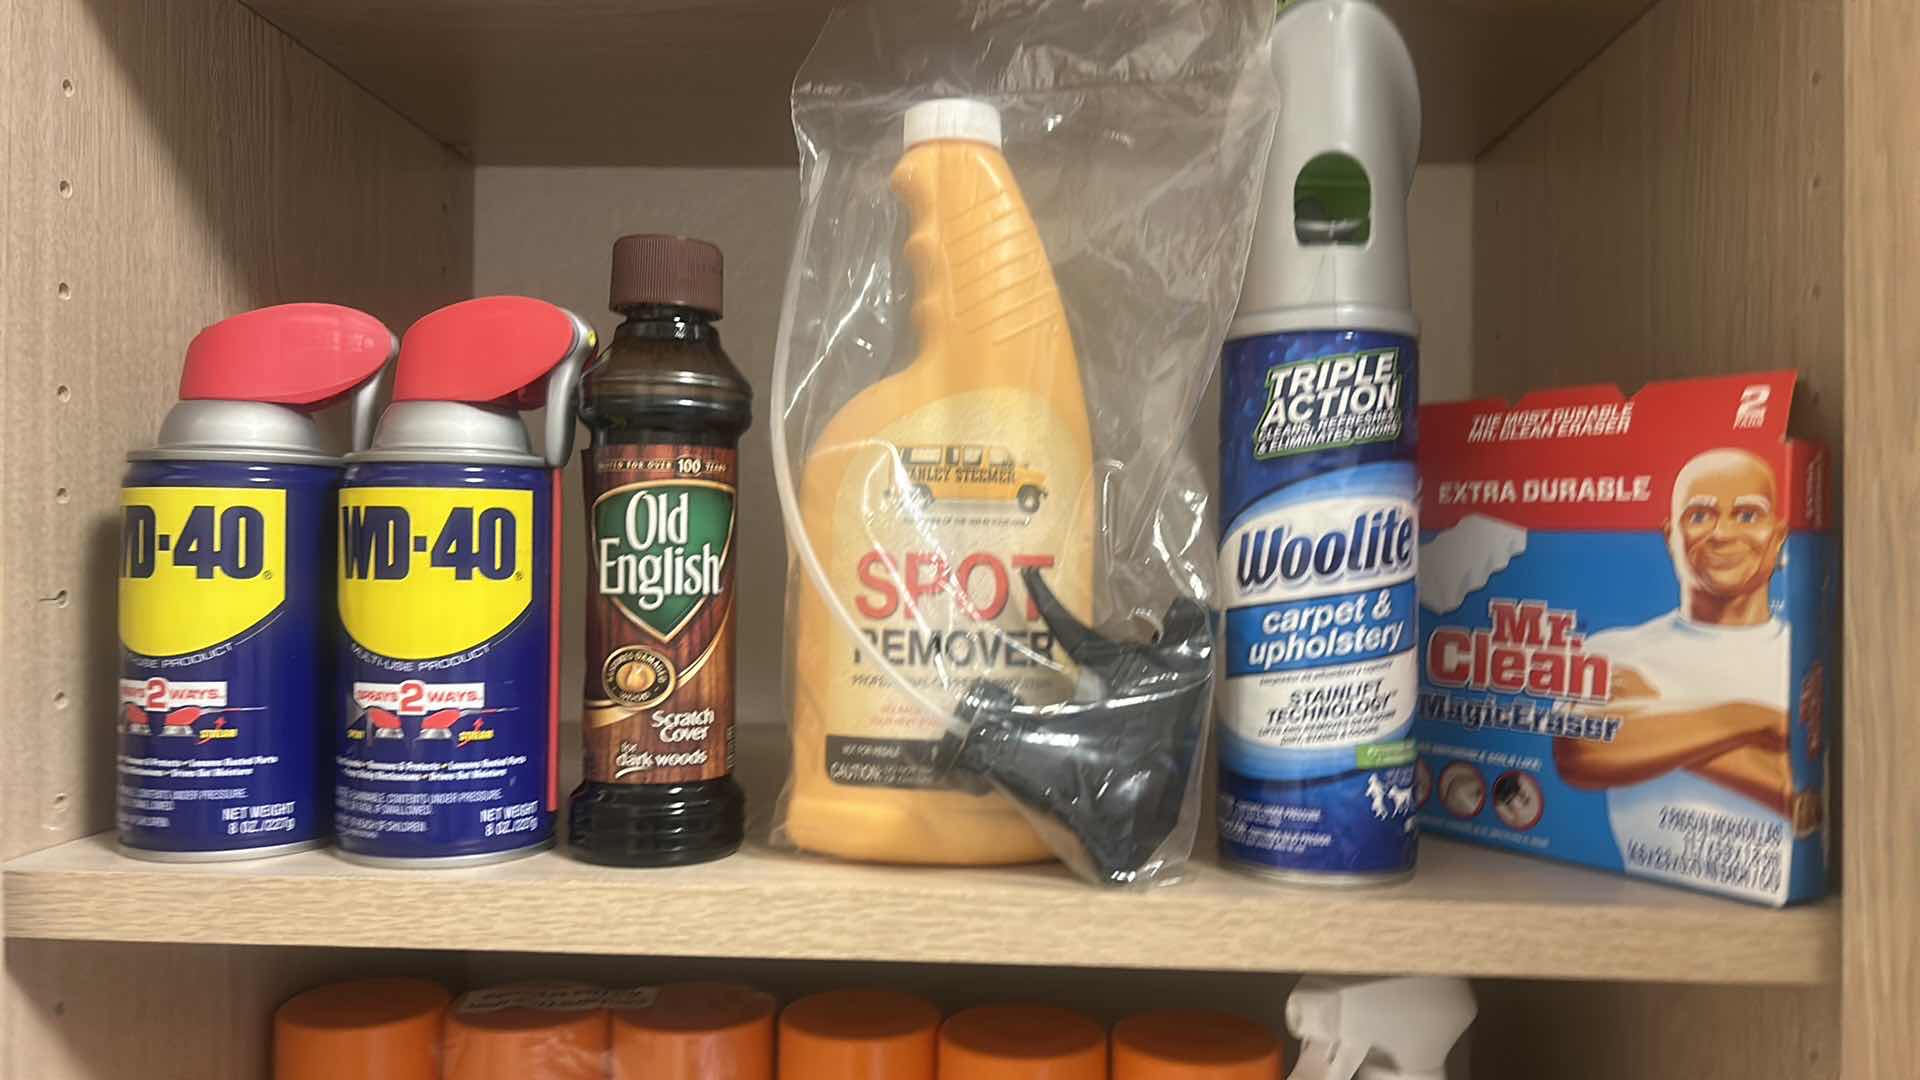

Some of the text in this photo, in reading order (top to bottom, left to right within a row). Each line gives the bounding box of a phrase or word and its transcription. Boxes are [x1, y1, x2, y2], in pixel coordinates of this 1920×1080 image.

[1271, 352, 1393, 398] TRIPLE
[1262, 379, 1398, 429] ACTION
[1739, 385, 1771, 414] 2
[1472, 400, 1635, 430] THE MOST DURABLE
[1500, 423, 1554, 442] CLEAN
[1557, 417, 1631, 438] ERASER
[1268, 429, 1354, 454] ELIMINATES
[677, 459, 702, 473] 100
[955, 465, 1016, 483] STEEMER
[1438, 475, 1652, 505] EXTRA DURABLE
[626, 491, 689, 550] Old
[125, 505, 264, 579] D-40
[341, 506, 517, 580] WD-40
[1237, 508, 1413, 588] Woolite
[599, 537, 722, 610] English
[855, 551, 1055, 621] SPOT
[1263, 588, 1392, 635] carpet &
[1490, 599, 1585, 650] Mr.
[161, 643, 234, 669] PRODUCT
[417, 643, 492, 671] PRODUCT
[1248, 621, 1405, 671] upholstery
[1427, 625, 1612, 704] Clean
[151, 679, 166, 709] 2
[400, 682, 424, 712] 2
[429, 690, 480, 702] WAYS
[1290, 680, 1383, 705] STAINLIFT
[652, 708, 714, 728] Scratch
[1268, 693, 1392, 725] TECHNOLOGY
[660, 725, 710, 743] Cover
[615, 749, 708, 767] dark woods
[222, 801, 297, 821] NET WEIGHT
[480, 801, 538, 823] NET WEIGHT
[227, 822, 239, 835] 8
[485, 823, 495, 837] 8
